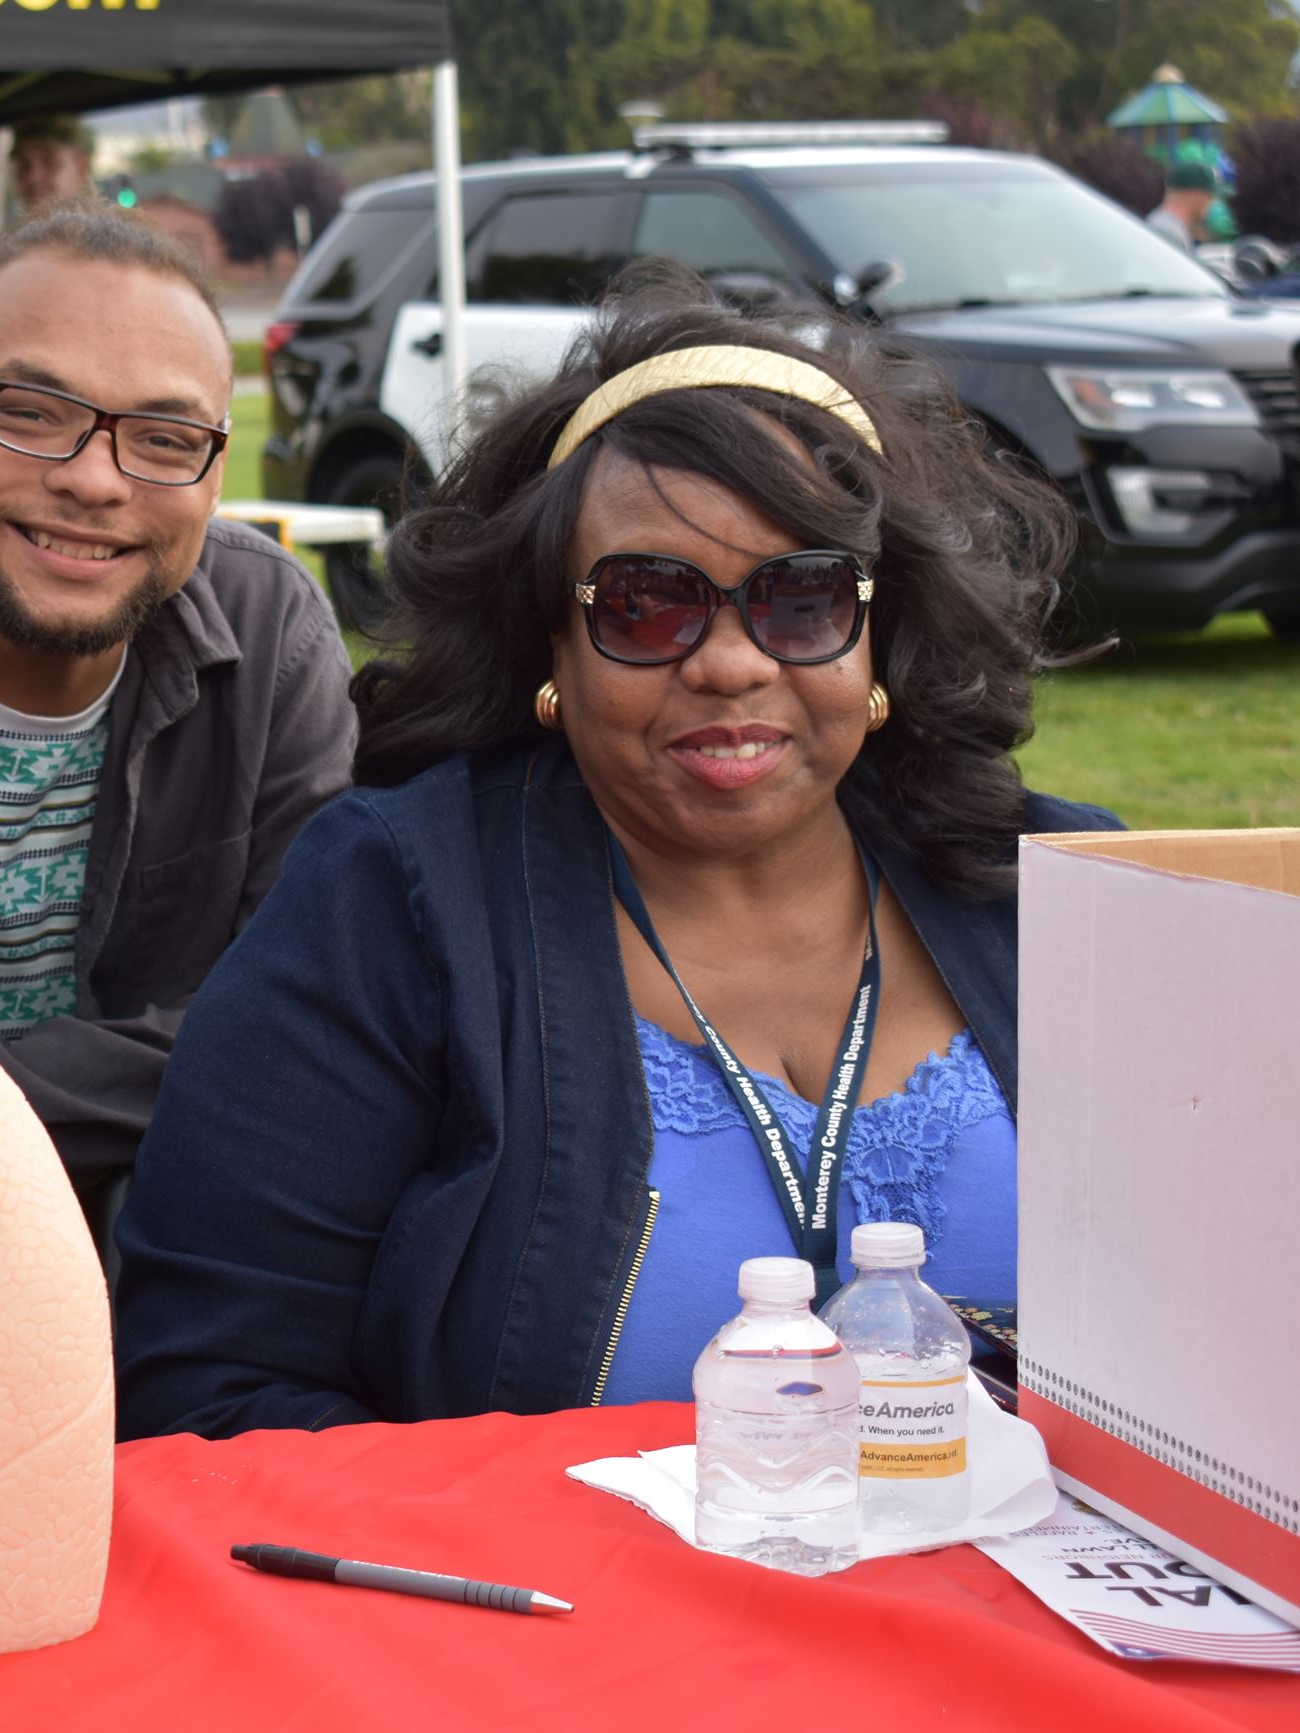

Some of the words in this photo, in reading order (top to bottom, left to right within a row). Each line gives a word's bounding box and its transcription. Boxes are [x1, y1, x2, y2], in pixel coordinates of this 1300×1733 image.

[843, 984, 872, 1061] Department
[832, 1060, 856, 1101] Health
[705, 1025, 741, 1075] County
[736, 1076, 772, 1126] Health
[765, 1128, 805, 1230] Departme
[821, 1102, 848, 1148] County
[812, 1151, 837, 1230] Monterey
[868, 1425, 894, 1435] When
[897, 1429, 914, 1437] you
[917, 1426, 936, 1435] need
[1061, 1544, 1128, 1553] LAWN
